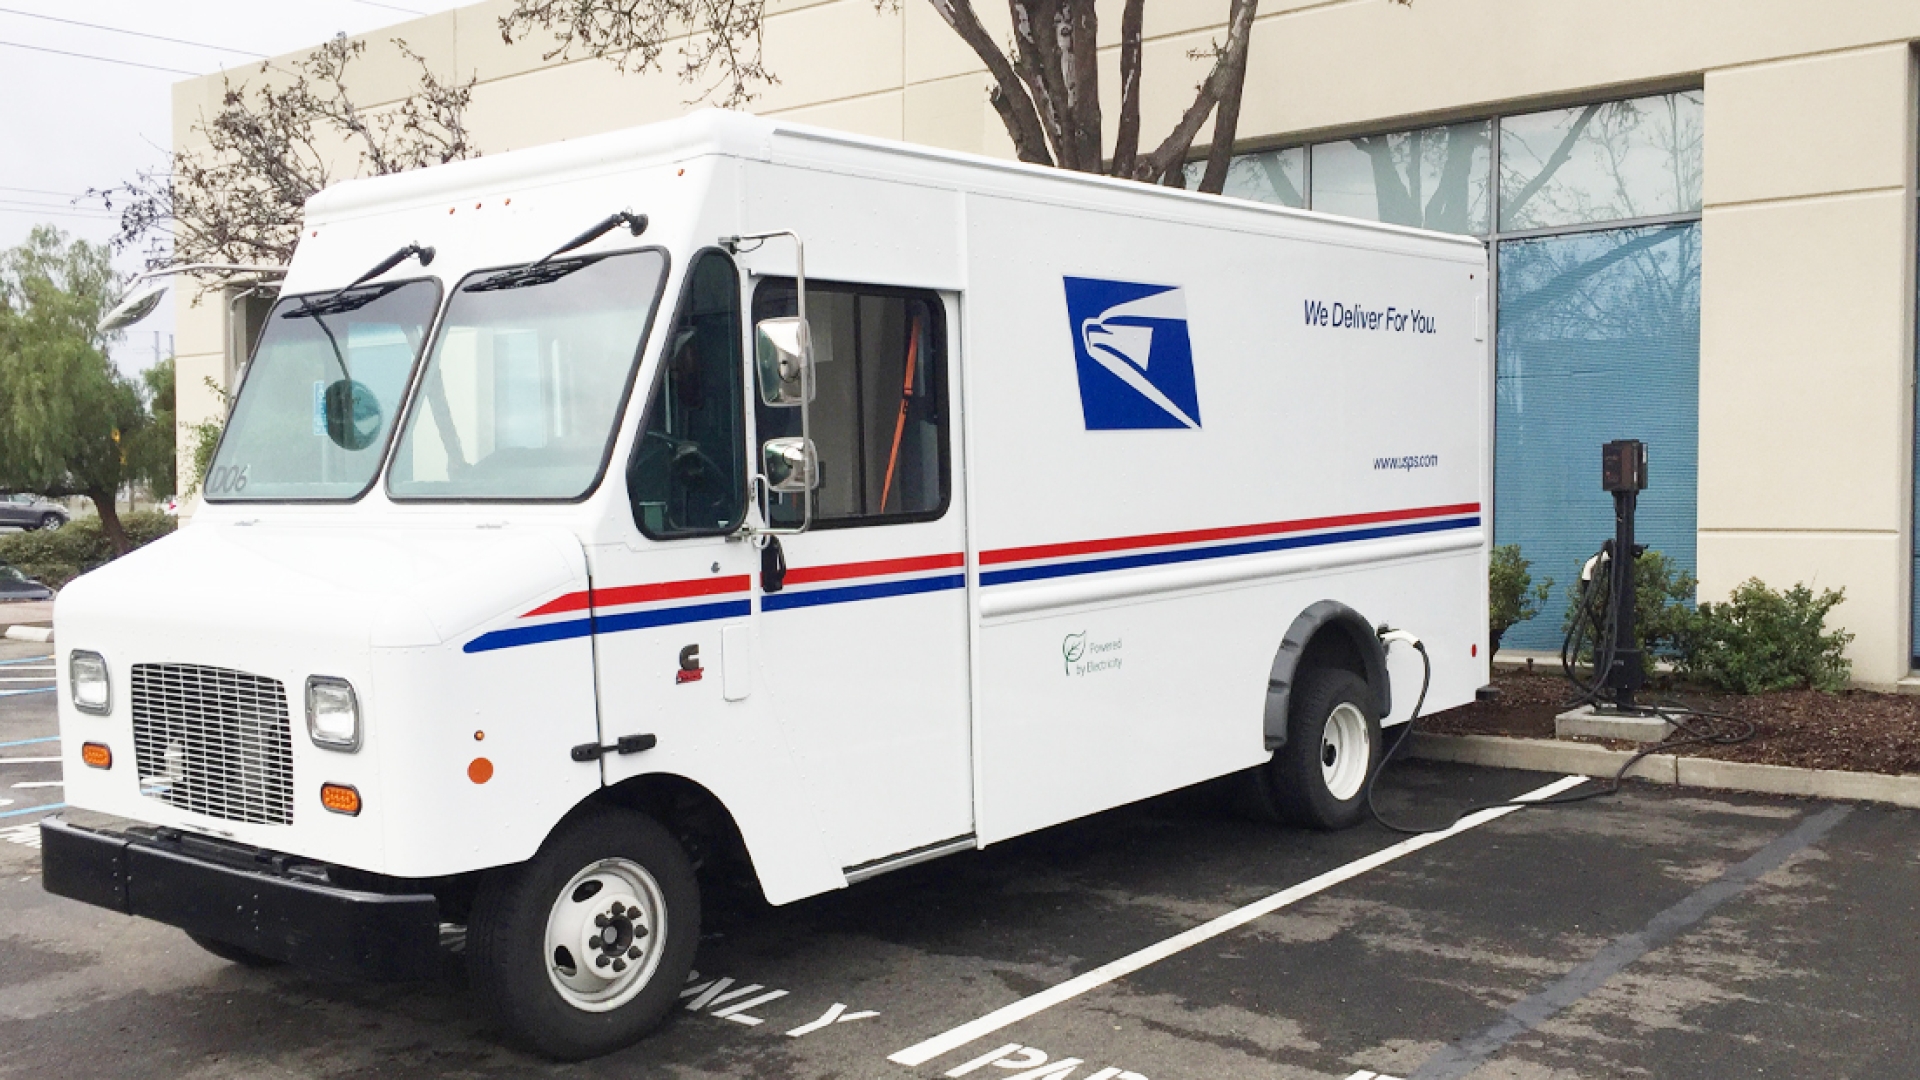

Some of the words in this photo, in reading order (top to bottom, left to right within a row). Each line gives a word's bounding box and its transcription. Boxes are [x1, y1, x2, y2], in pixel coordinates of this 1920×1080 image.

[1304, 299, 1328, 327] We
[1332, 302, 1383, 330] Deliver
[1385, 306, 1408, 331] For
[1411, 309, 1437, 334] You.
[1373, 454, 1438, 472] www.usps.com
[1089, 637, 1123, 654] Powered
[1076, 664, 1086, 677] by
[1087, 657, 1123, 674] Electricity
[679, 970, 881, 1037] NLY
